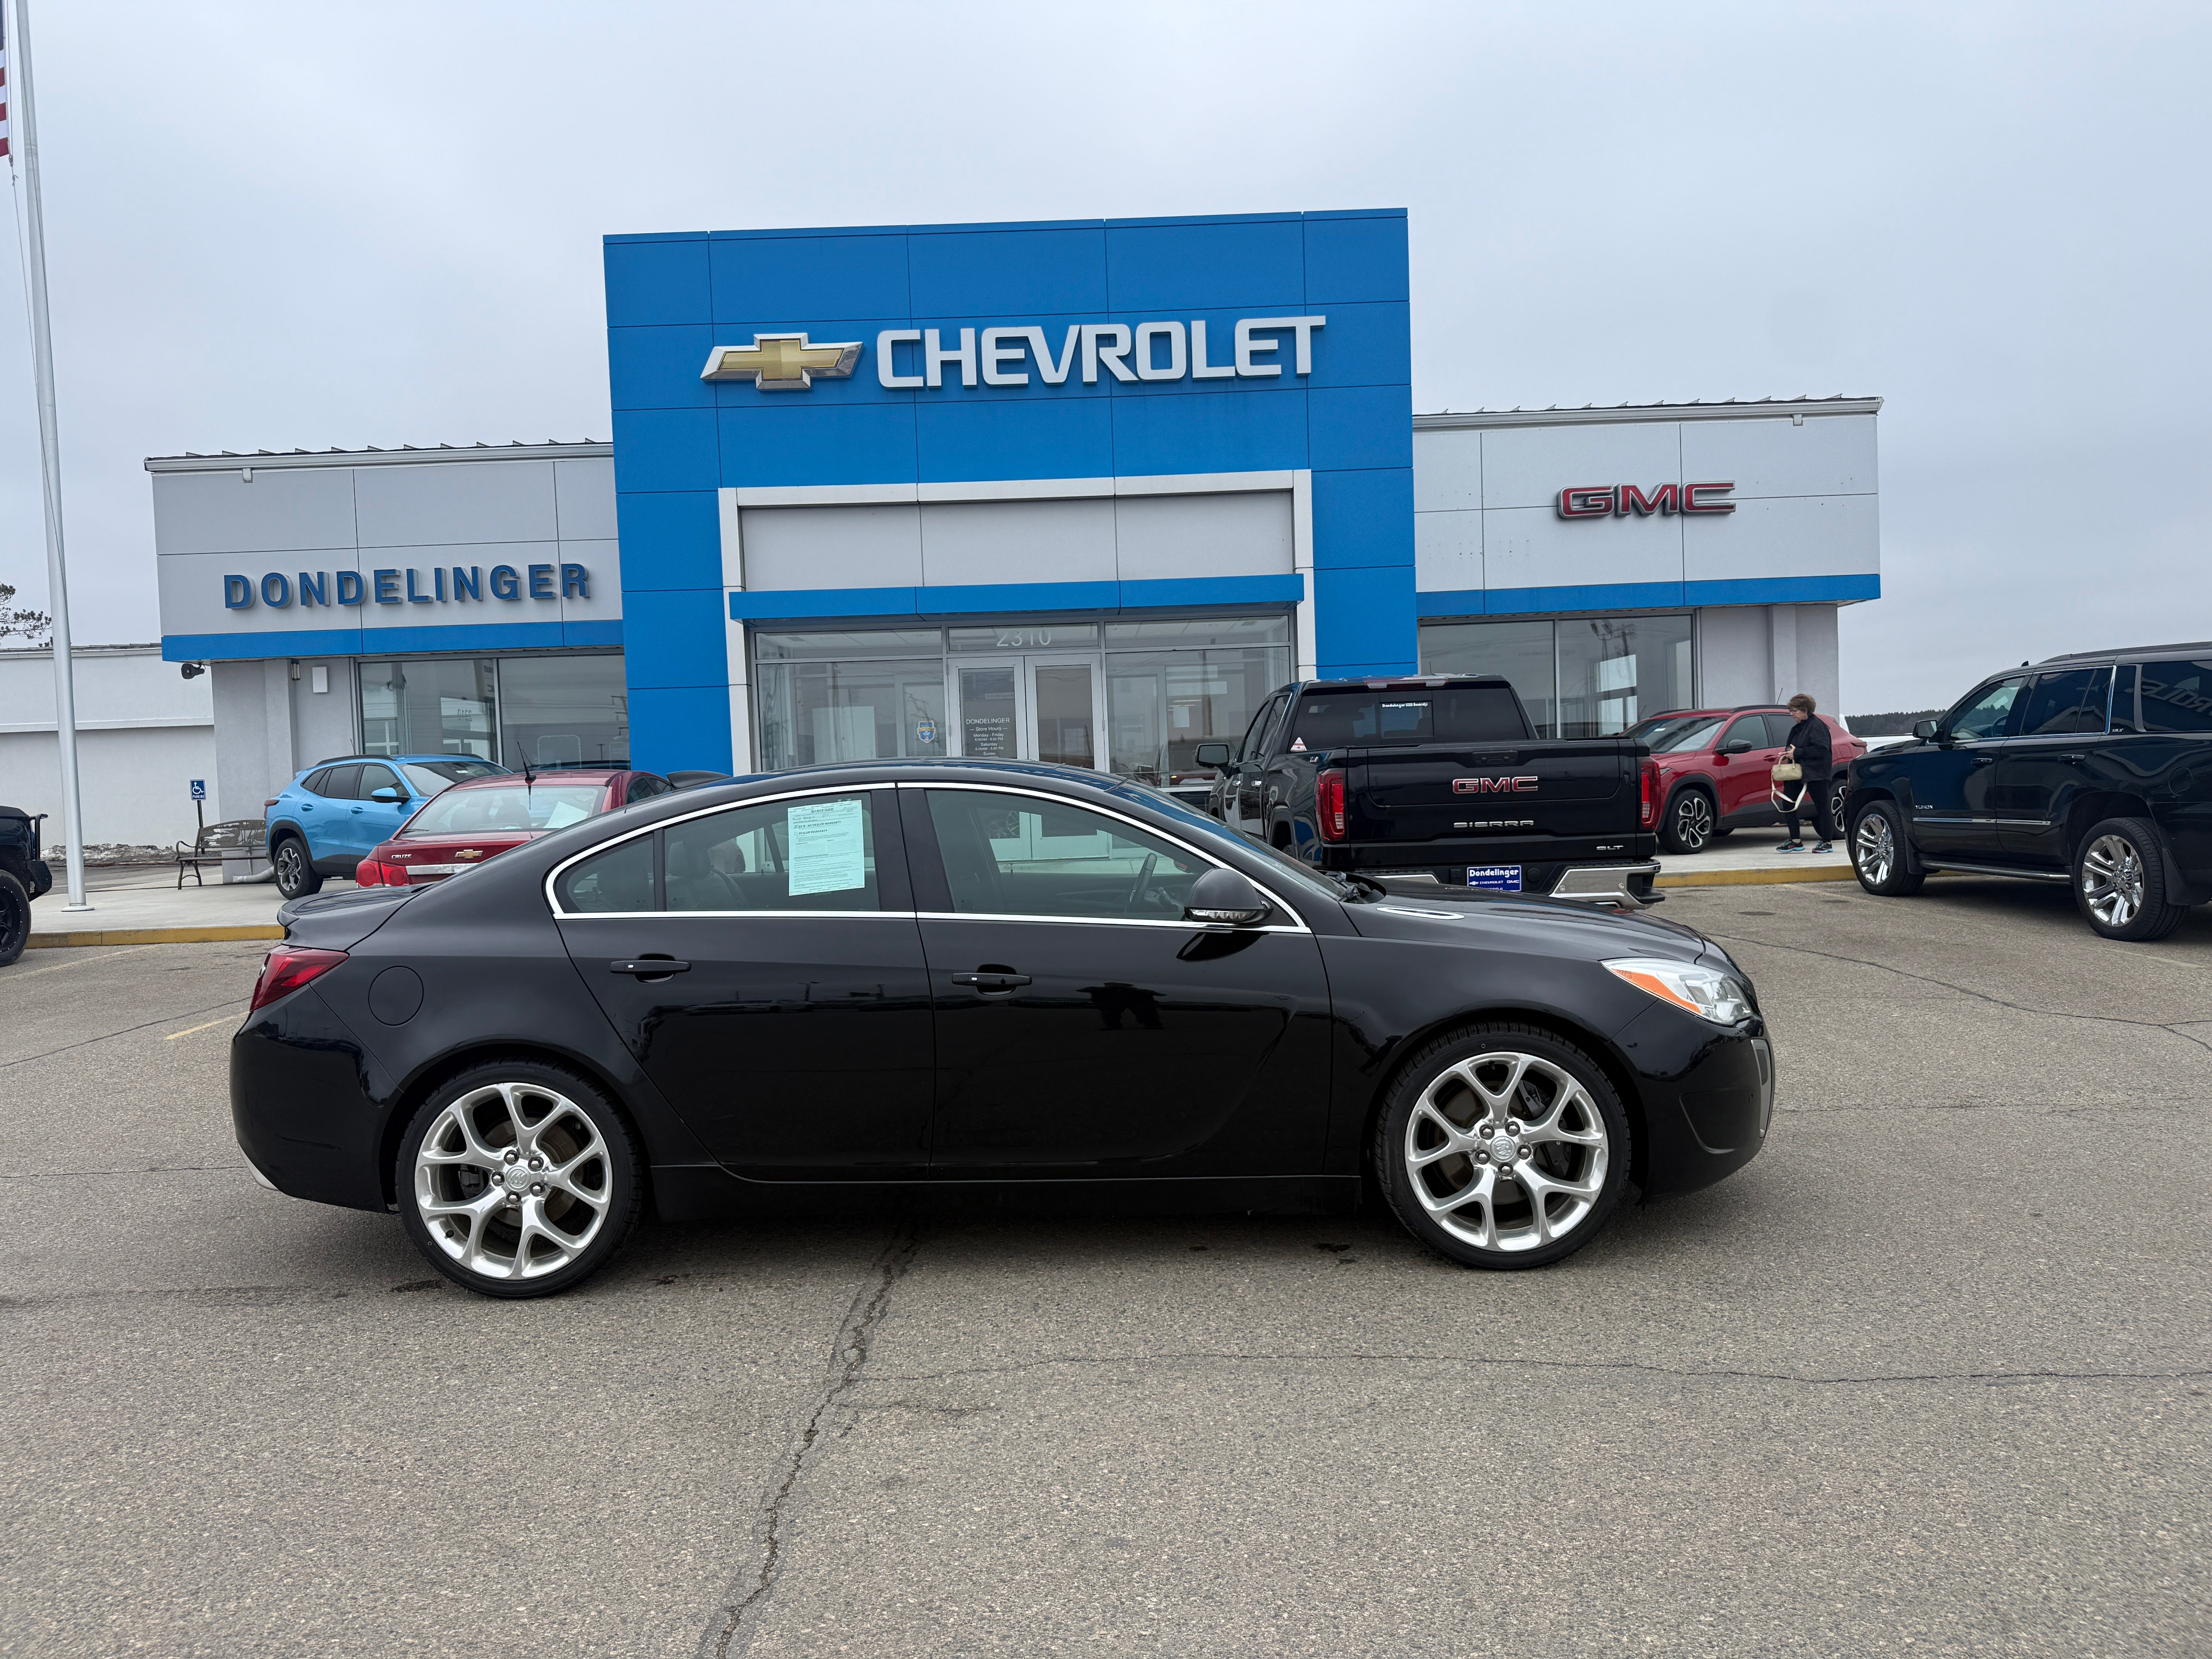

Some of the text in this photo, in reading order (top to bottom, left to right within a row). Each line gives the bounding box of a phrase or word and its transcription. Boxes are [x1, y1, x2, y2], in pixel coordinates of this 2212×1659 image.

[877, 316, 1326, 387] CHEVROLET
[1558, 481, 1736, 519] GMC
[224, 563, 590, 609] DONDELINGER
[997, 630, 1051, 647] 2310
[1453, 776, 1538, 794] GMC
[1470, 869, 1519, 878] Dondelinger
